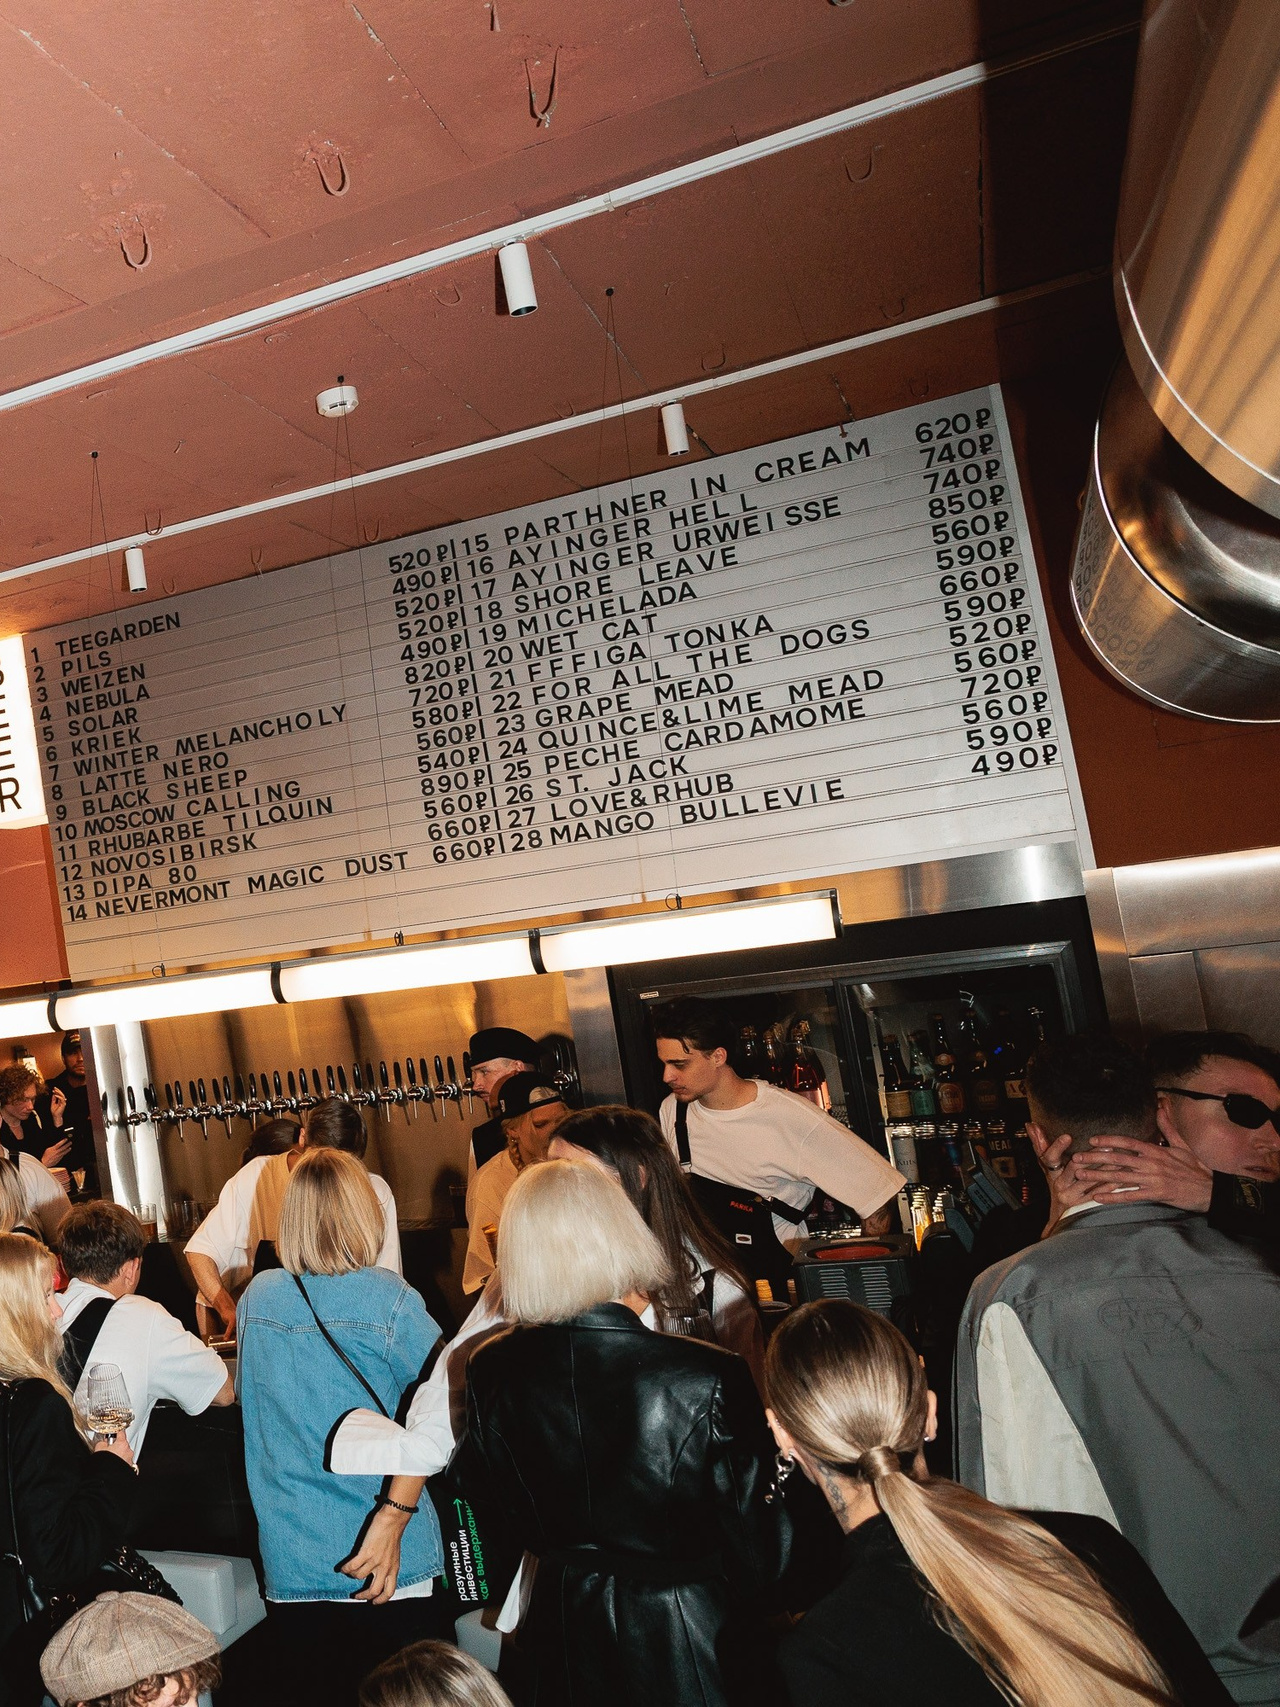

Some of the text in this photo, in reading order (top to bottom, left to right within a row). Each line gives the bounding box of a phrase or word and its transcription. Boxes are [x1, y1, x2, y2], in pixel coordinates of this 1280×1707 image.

[461, 533, 490, 556] 15
[504, 489, 668, 546] PARTHNER
[690, 473, 727, 500] IN
[754, 437, 871, 483] CREAM
[466, 555, 494, 578] 16
[508, 517, 651, 570] AYINGER
[669, 493, 758, 530] HELL
[471, 577, 496, 600] 17
[511, 541, 655, 592] AYINGER
[672, 496, 842, 553] URWEISSE
[474, 600, 503, 623] 18
[514, 574, 614, 614] SHORE
[638, 545, 739, 587] LEAVE
[478, 623, 507, 646] 19
[517, 581, 698, 638] MICHELADA
[30, 647, 40, 664] 1
[54, 611, 181, 657] TEEGARDEN
[33, 665, 46, 684] 2
[61, 650, 112, 678] PILS
[483, 645, 514, 669] 20
[519, 630, 579, 660] WET
[602, 612, 657, 642] CAT
[489, 668, 516, 691] 21
[527, 641, 647, 683] FFFIGA
[664, 614, 775, 653] TONKA
[492, 691, 523, 714] 22
[532, 676, 592, 706] FOR
[611, 661, 672, 690] ALL
[686, 642, 753, 674] THE
[779, 619, 870, 656] DOGS
[36, 686, 49, 703] 3
[60, 662, 146, 698] WEIZEN
[39, 705, 52, 722] 4
[65, 683, 151, 717] NEBULA
[495, 713, 526, 737] 23
[535, 692, 633, 728] GRAPE
[654, 672, 734, 706] MEAD
[42, 725, 55, 743] 5
[68, 707, 139, 737] SOLAR
[45, 745, 58, 762] 6
[71, 726, 142, 757] KRIEK
[48, 764, 59, 782] 7
[72, 744, 160, 777] WINTER
[175, 703, 346, 757] MELANCHOLY
[498, 737, 528, 760] 24
[538, 691, 765, 750] QUINCE&LIME
[788, 669, 884, 705] MEAD
[503, 759, 532, 783] 25
[544, 739, 640, 775] PECHE
[664, 697, 866, 752] CARDAMOME
[51, 784, 64, 801] 8
[79, 767, 147, 797] LATTE
[162, 751, 229, 780] NERO
[55, 804, 67, 821] 9
[82, 787, 151, 817] BLACK
[166, 769, 248, 800] SHEEP
[505, 783, 534, 806] 26
[546, 773, 589, 798] ST.
[608, 755, 689, 787] JACK
[507, 806, 536, 829] 27
[550, 773, 734, 822] LOVE&RHUB
[55, 823, 78, 842] 10
[84, 804, 175, 838] MOSCOW
[186, 780, 301, 818] CALLING
[58, 843, 77, 862] 11
[88, 820, 206, 857] RHUBARBE
[222, 796, 333, 832] TILQUIN
[510, 829, 543, 852] 28
[549, 811, 654, 846] MANGO
[679, 778, 845, 825] BULLEVIE
[60, 863, 83, 882] 12
[90, 832, 258, 877] NOVOSIBIRSK
[63, 883, 85, 902] 13
[93, 873, 153, 898] DIPA
[168, 864, 197, 885] 80
[67, 904, 88, 922] 14
[95, 880, 231, 919] NEVERMONT
[247, 865, 325, 895] MAGIC
[344, 851, 408, 877] DUST
[450, 1541, 470, 1601] разумные
[458, 1529, 479, 1601] инвестиции
[479, 1579, 490, 1600] как
